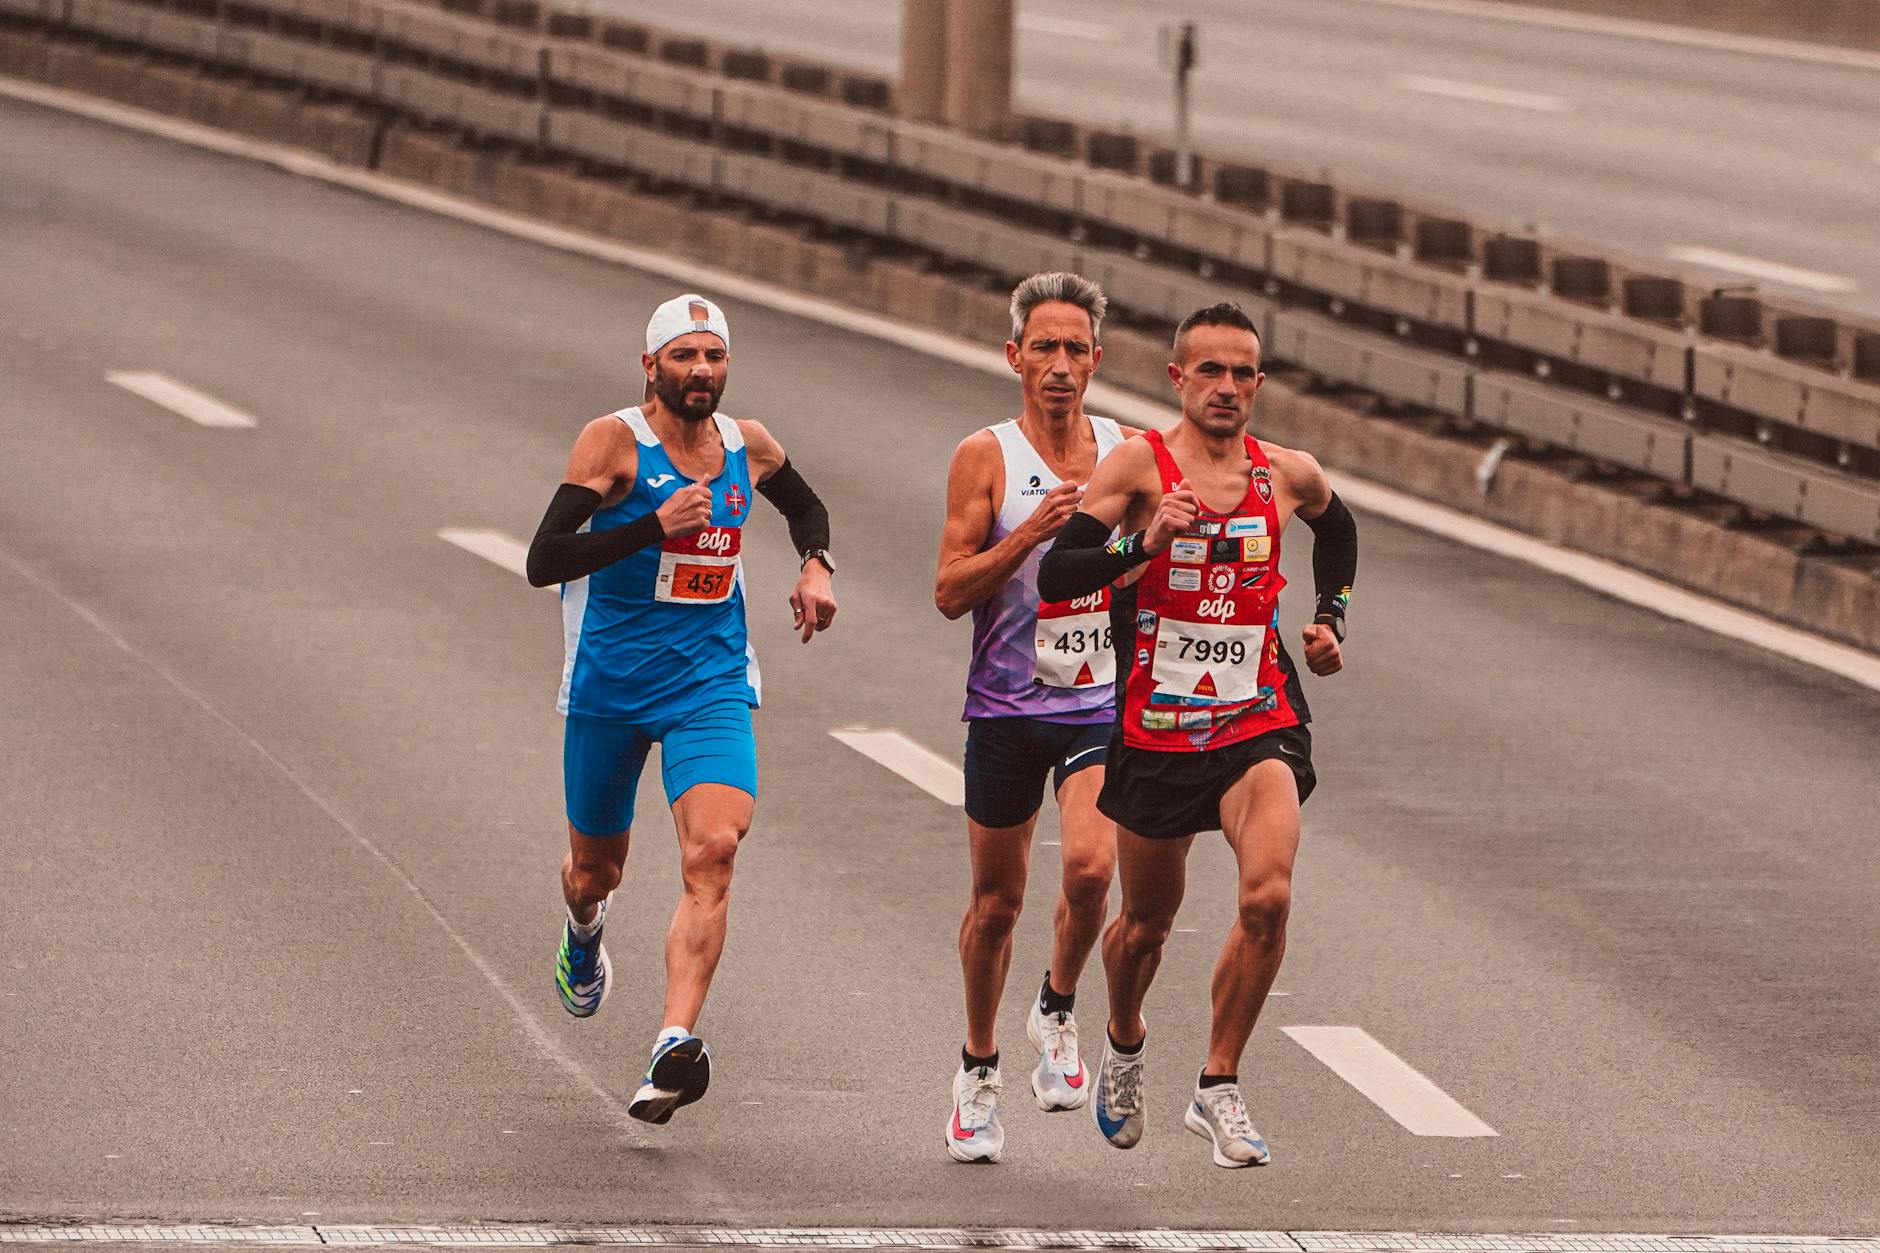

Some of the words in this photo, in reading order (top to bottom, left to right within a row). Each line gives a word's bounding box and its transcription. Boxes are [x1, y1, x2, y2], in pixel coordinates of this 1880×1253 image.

[696, 527, 732, 556] edp
[687, 573, 724, 595] 457
[1197, 594, 1236, 624] edp
[1054, 626, 1112, 655] 4318
[1178, 636, 1246, 665] 7999
